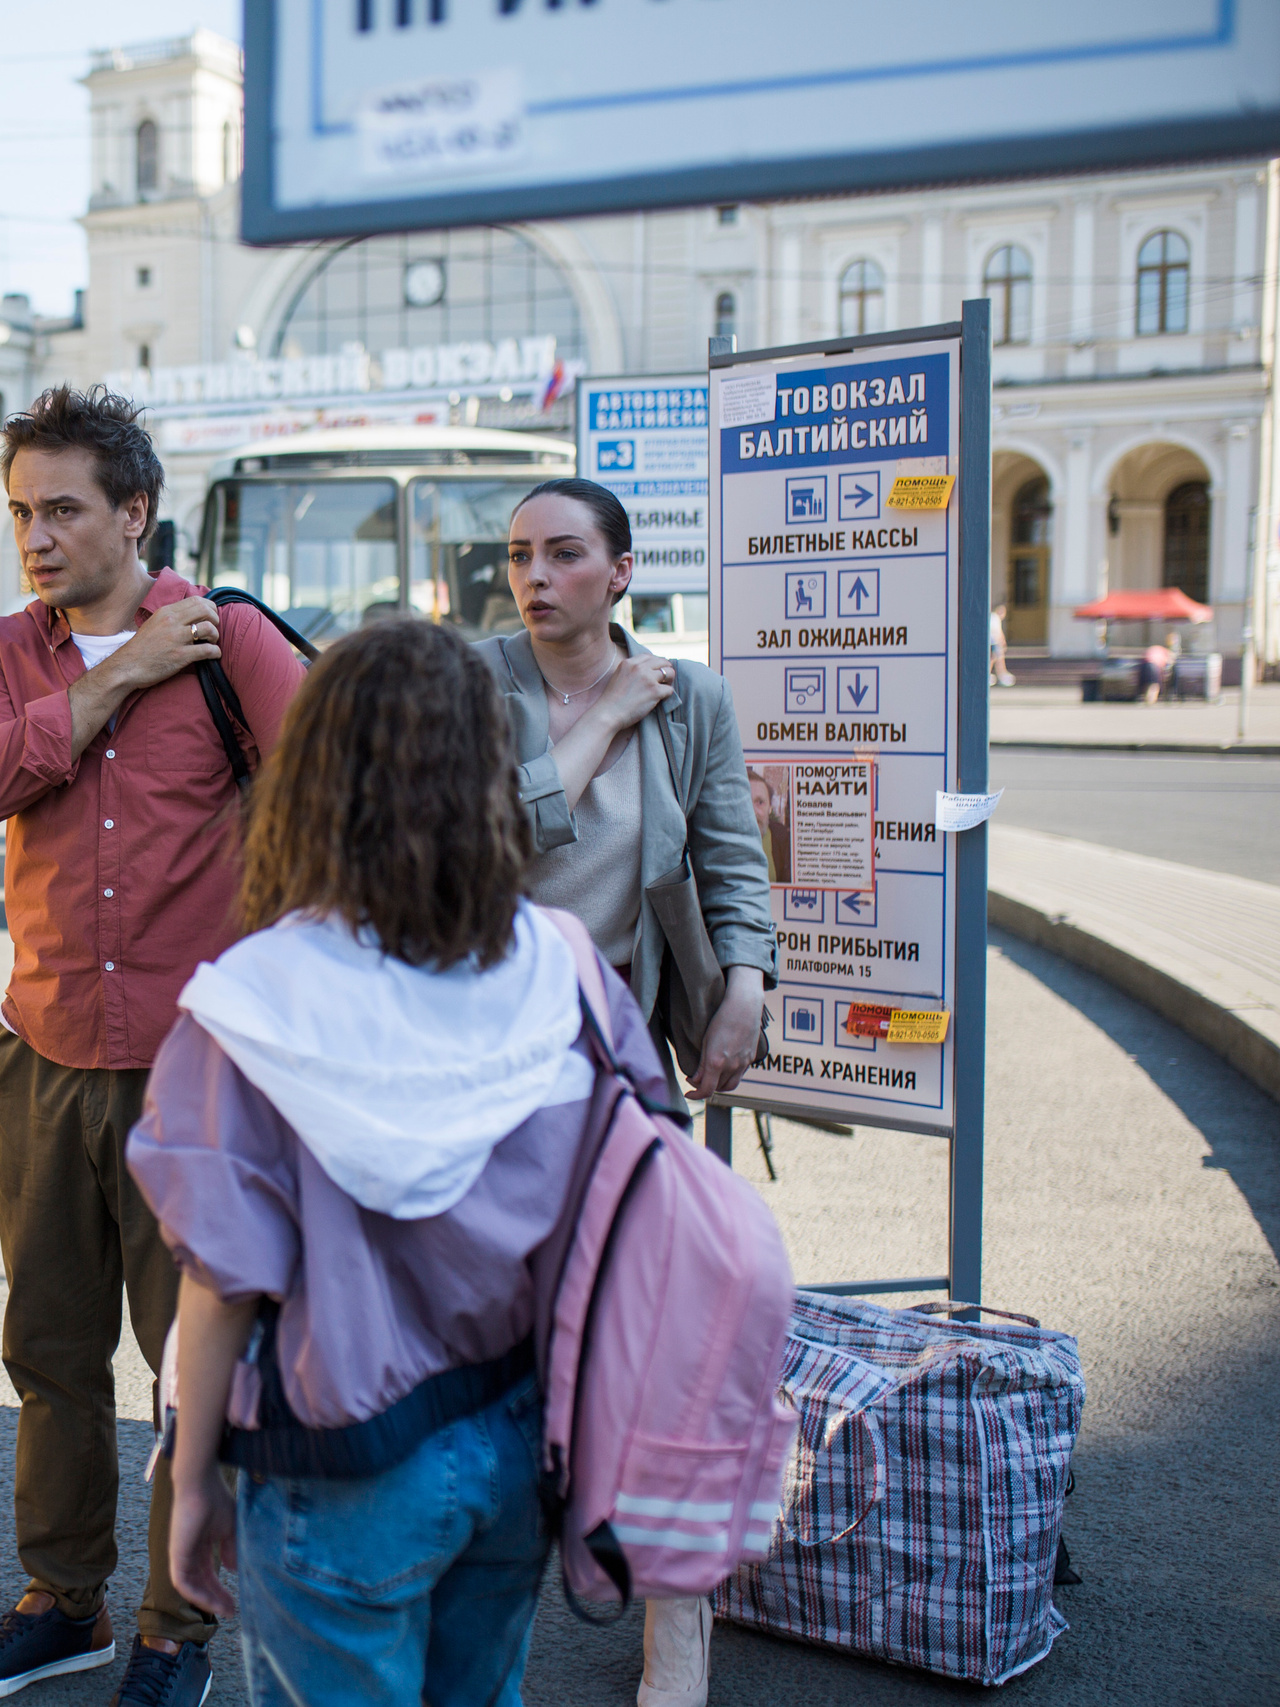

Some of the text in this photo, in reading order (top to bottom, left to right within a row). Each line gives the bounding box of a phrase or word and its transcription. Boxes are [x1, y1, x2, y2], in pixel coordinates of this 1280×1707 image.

[383, 335, 556, 388] ВОКЗАЛ
[597, 389, 708, 411] АВТОВОКЗА
[777, 372, 926, 417] ТОВОКЗАЛ
[596, 408, 707, 429] БАЛТИЙСКИ
[738, 407, 928, 460] БАЛТИЙСКИЙ
[896, 478, 947, 487] ПОМОЩЬ
[627, 508, 704, 528] ЕБЯЖЬЕ
[748, 526, 918, 556] БИЛЕТНЫЕ КАССЫ
[632, 547, 705, 567] ТИНОВО
[757, 626, 908, 650] ЗАЛ ОЖИДАНИЯ
[757, 722, 907, 742] ОБМЕН ВАЛЮТЫ
[796, 765, 867, 778] ПОМОГИТЕ
[796, 777, 867, 796] НАЙТИ
[796, 799, 833, 808] Ковалев
[777, 931, 920, 962] РОН ПРИБЫТИЯ
[787, 959, 872, 978] ПЛАТФОРМА 15
[853, 1003, 892, 1016] ПОМОЩ
[893, 1012, 943, 1021] ПОМОЩЬ
[889, 1030, 940, 1040] 8-921-570-0505
[751, 1053, 917, 1090] АМЕРА ХРАНЕНИЯ
